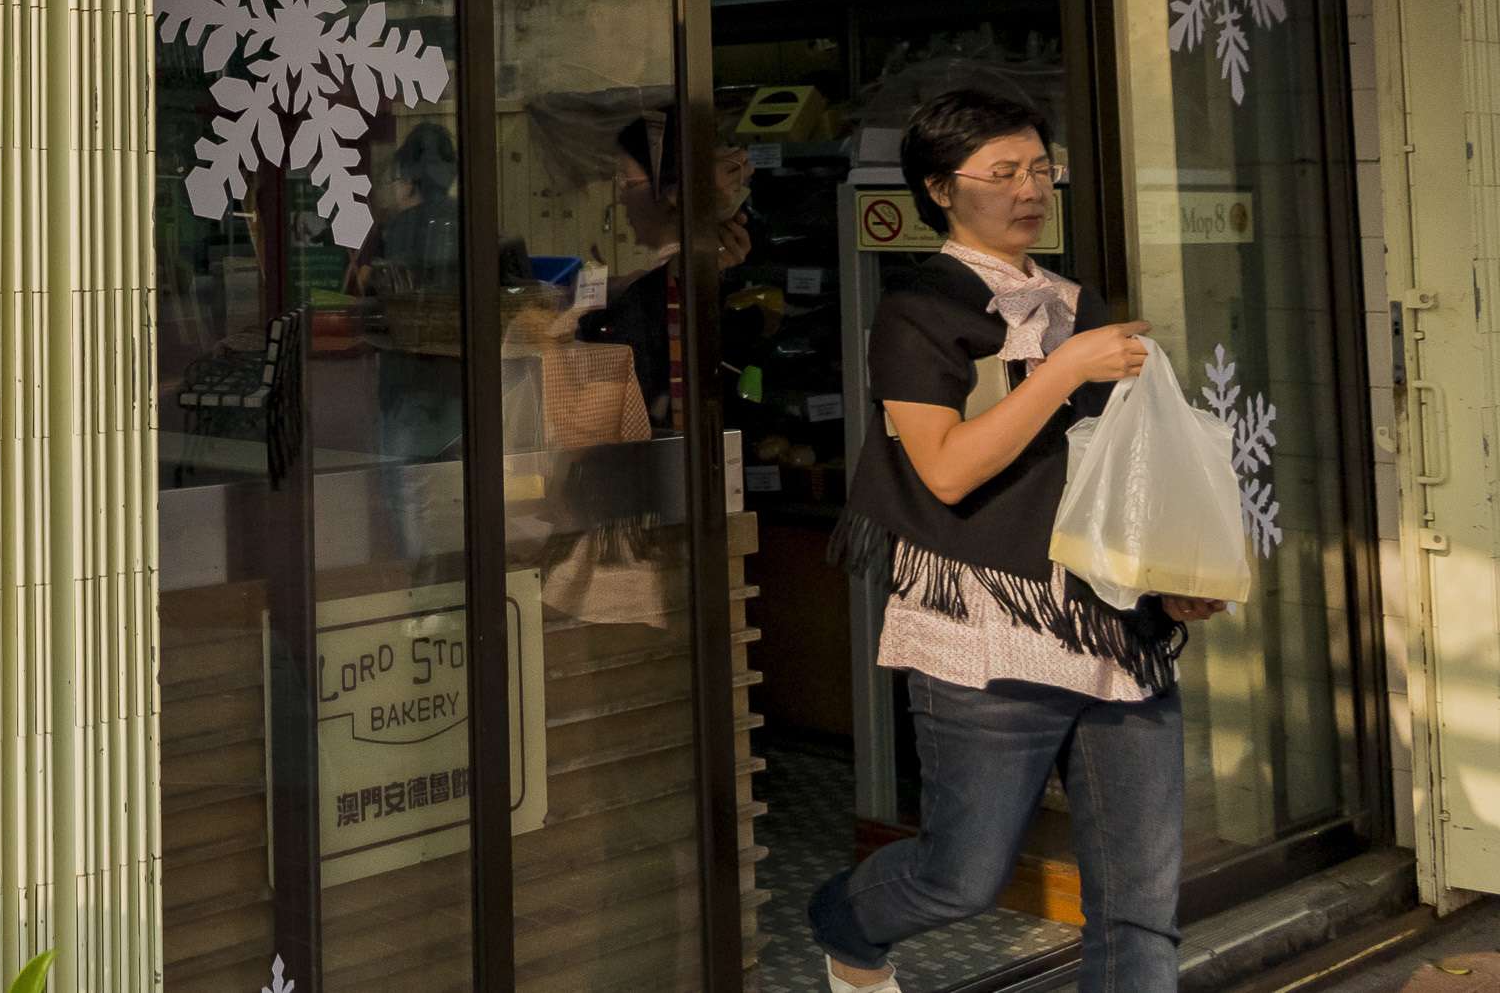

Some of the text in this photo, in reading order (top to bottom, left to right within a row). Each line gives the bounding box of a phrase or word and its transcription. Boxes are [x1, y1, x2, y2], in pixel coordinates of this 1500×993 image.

[318, 636, 466, 703] LORD STO
[370, 690, 460, 733] BAKERY
[336, 766, 471, 828] 澳門安德魯餅
